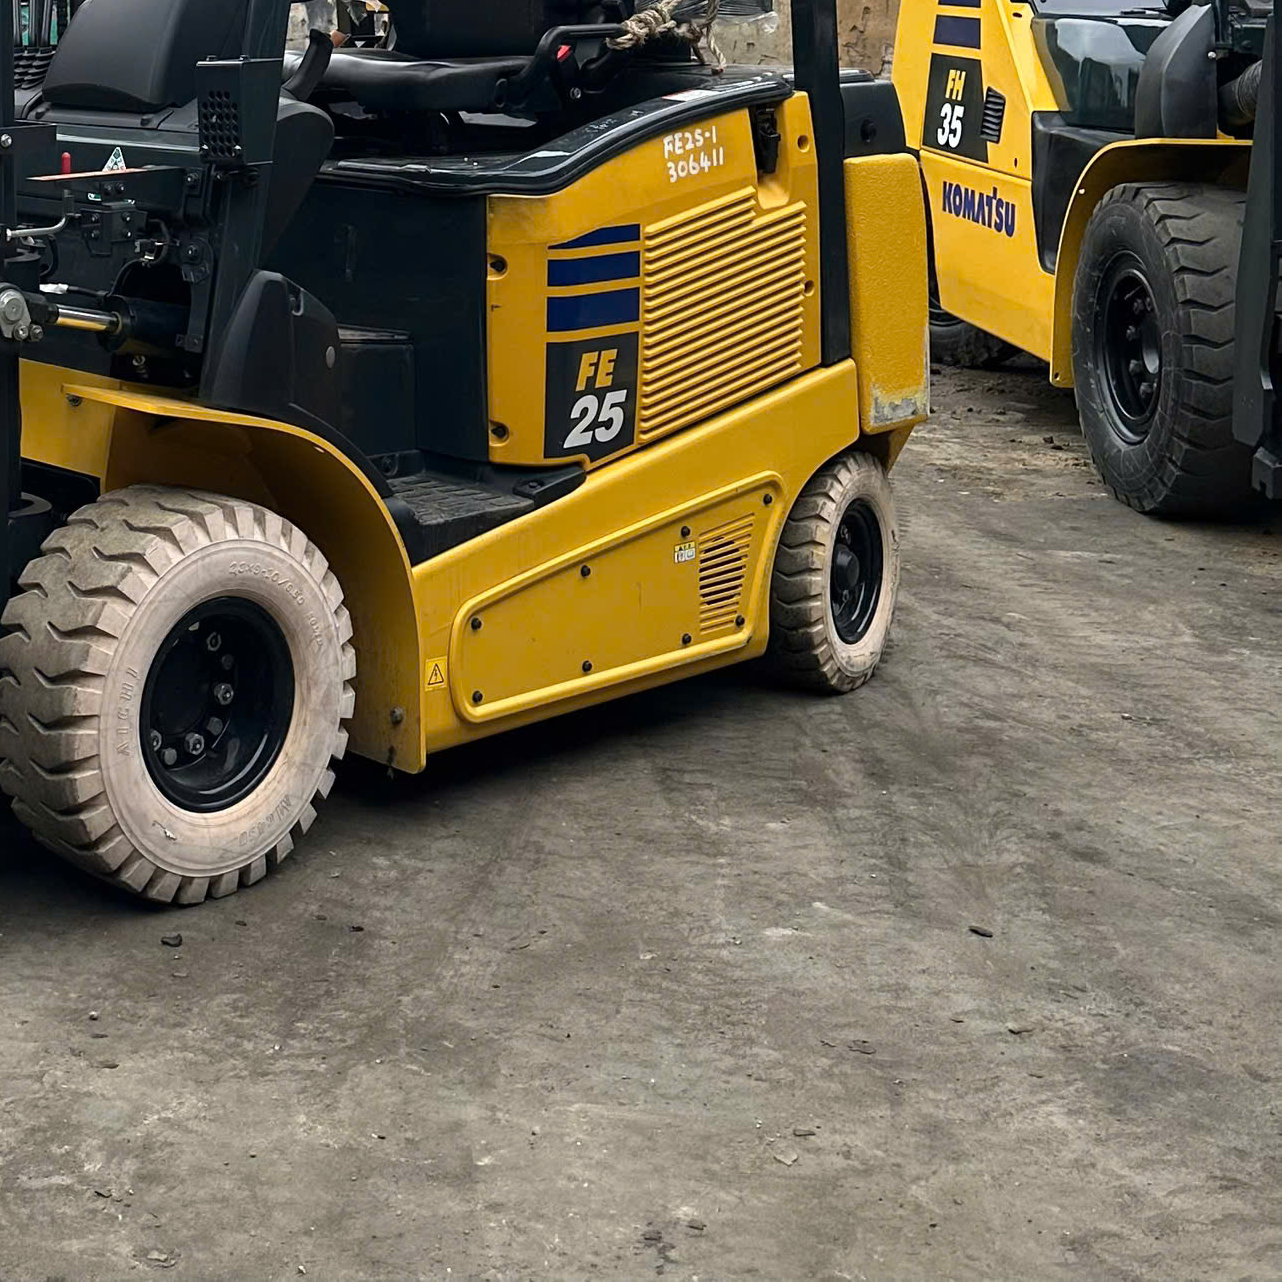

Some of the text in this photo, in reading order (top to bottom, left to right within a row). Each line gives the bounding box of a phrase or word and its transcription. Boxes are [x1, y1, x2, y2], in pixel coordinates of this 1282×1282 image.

[945, 69, 966, 101] FH
[937, 103, 965, 149] 35
[666, 146, 724, 183] 306411
[942, 180, 1016, 238] KOMATSU
[575, 349, 618, 392] FE
[563, 389, 628, 449] 25
